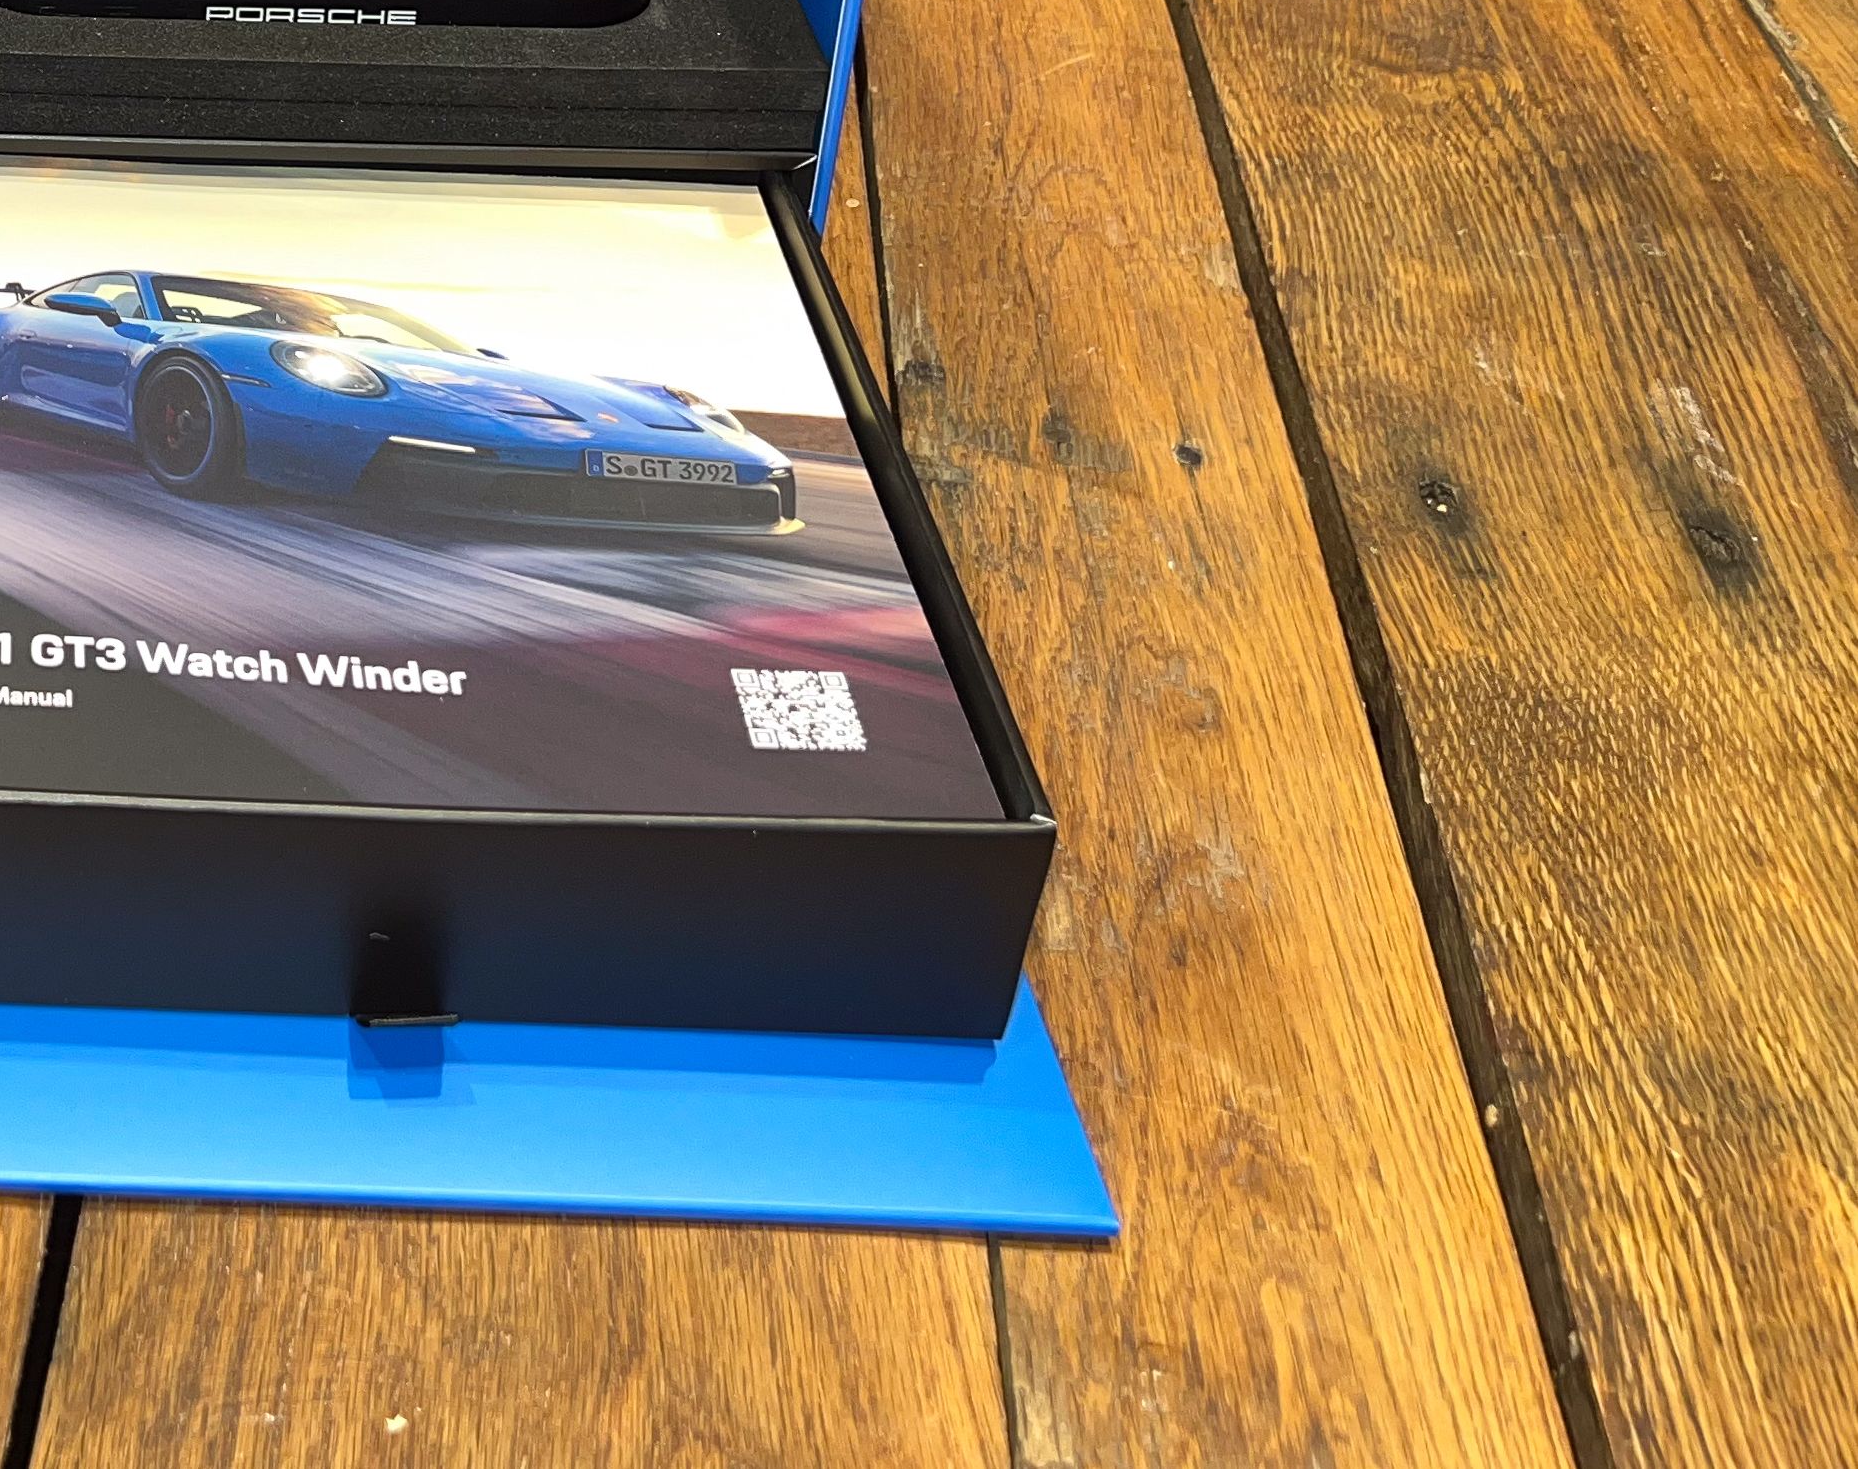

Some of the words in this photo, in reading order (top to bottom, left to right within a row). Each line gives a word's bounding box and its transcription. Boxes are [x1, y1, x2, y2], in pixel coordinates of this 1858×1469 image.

[205, 6, 417, 26] PORSCHE
[605, 455, 623, 477] S
[678, 461, 735, 483] 3992
[30, 633, 127, 671] GT3
[135, 639, 289, 684] Watch
[296, 652, 467, 701] Winder
